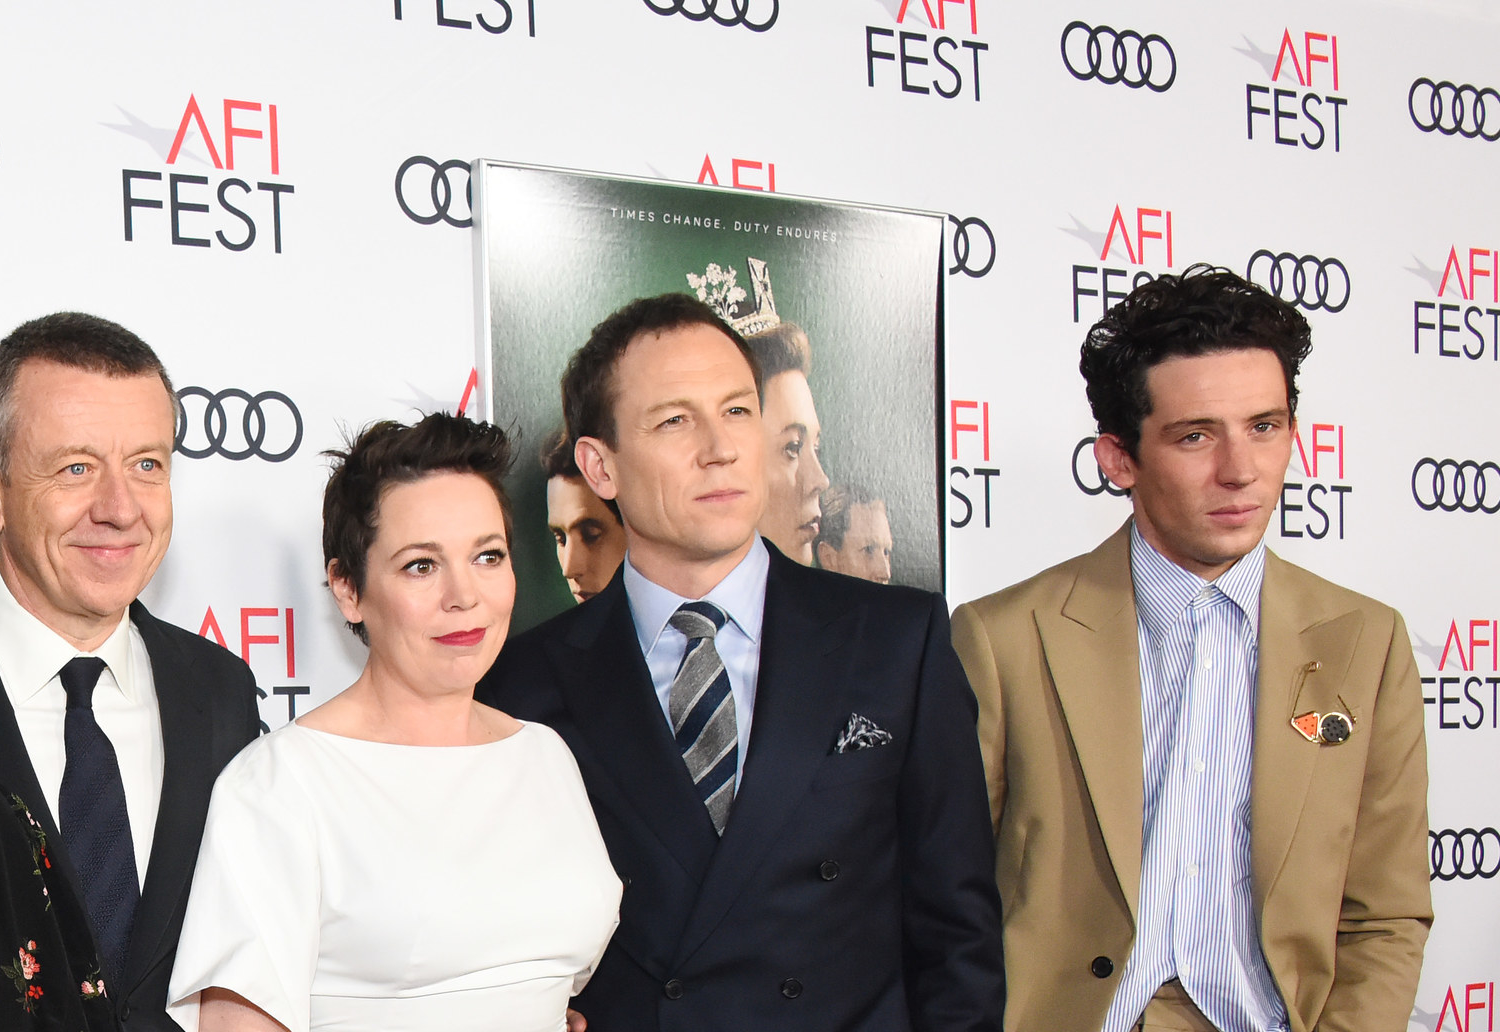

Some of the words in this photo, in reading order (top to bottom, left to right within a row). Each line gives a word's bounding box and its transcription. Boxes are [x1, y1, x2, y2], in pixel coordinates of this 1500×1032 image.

[866, 26, 988, 101] FEST
[1272, 27, 1338, 91] AFI
[166, 93, 279, 175] AFI
[1246, 83, 1348, 152] FEST
[122, 169, 295, 254] FEST
[610, 208, 655, 222] TIMES
[663, 213, 726, 230] CHANGE.
[734, 221, 770, 235] DUTY
[1100, 203, 1172, 268] AFI
[1437, 244, 1498, 303] AFI
[1414, 301, 1500, 361] FEST
[951, 400, 989, 461] FI
[1273, 483, 1352, 539] EST
[1438, 618, 1497, 671] AFI
